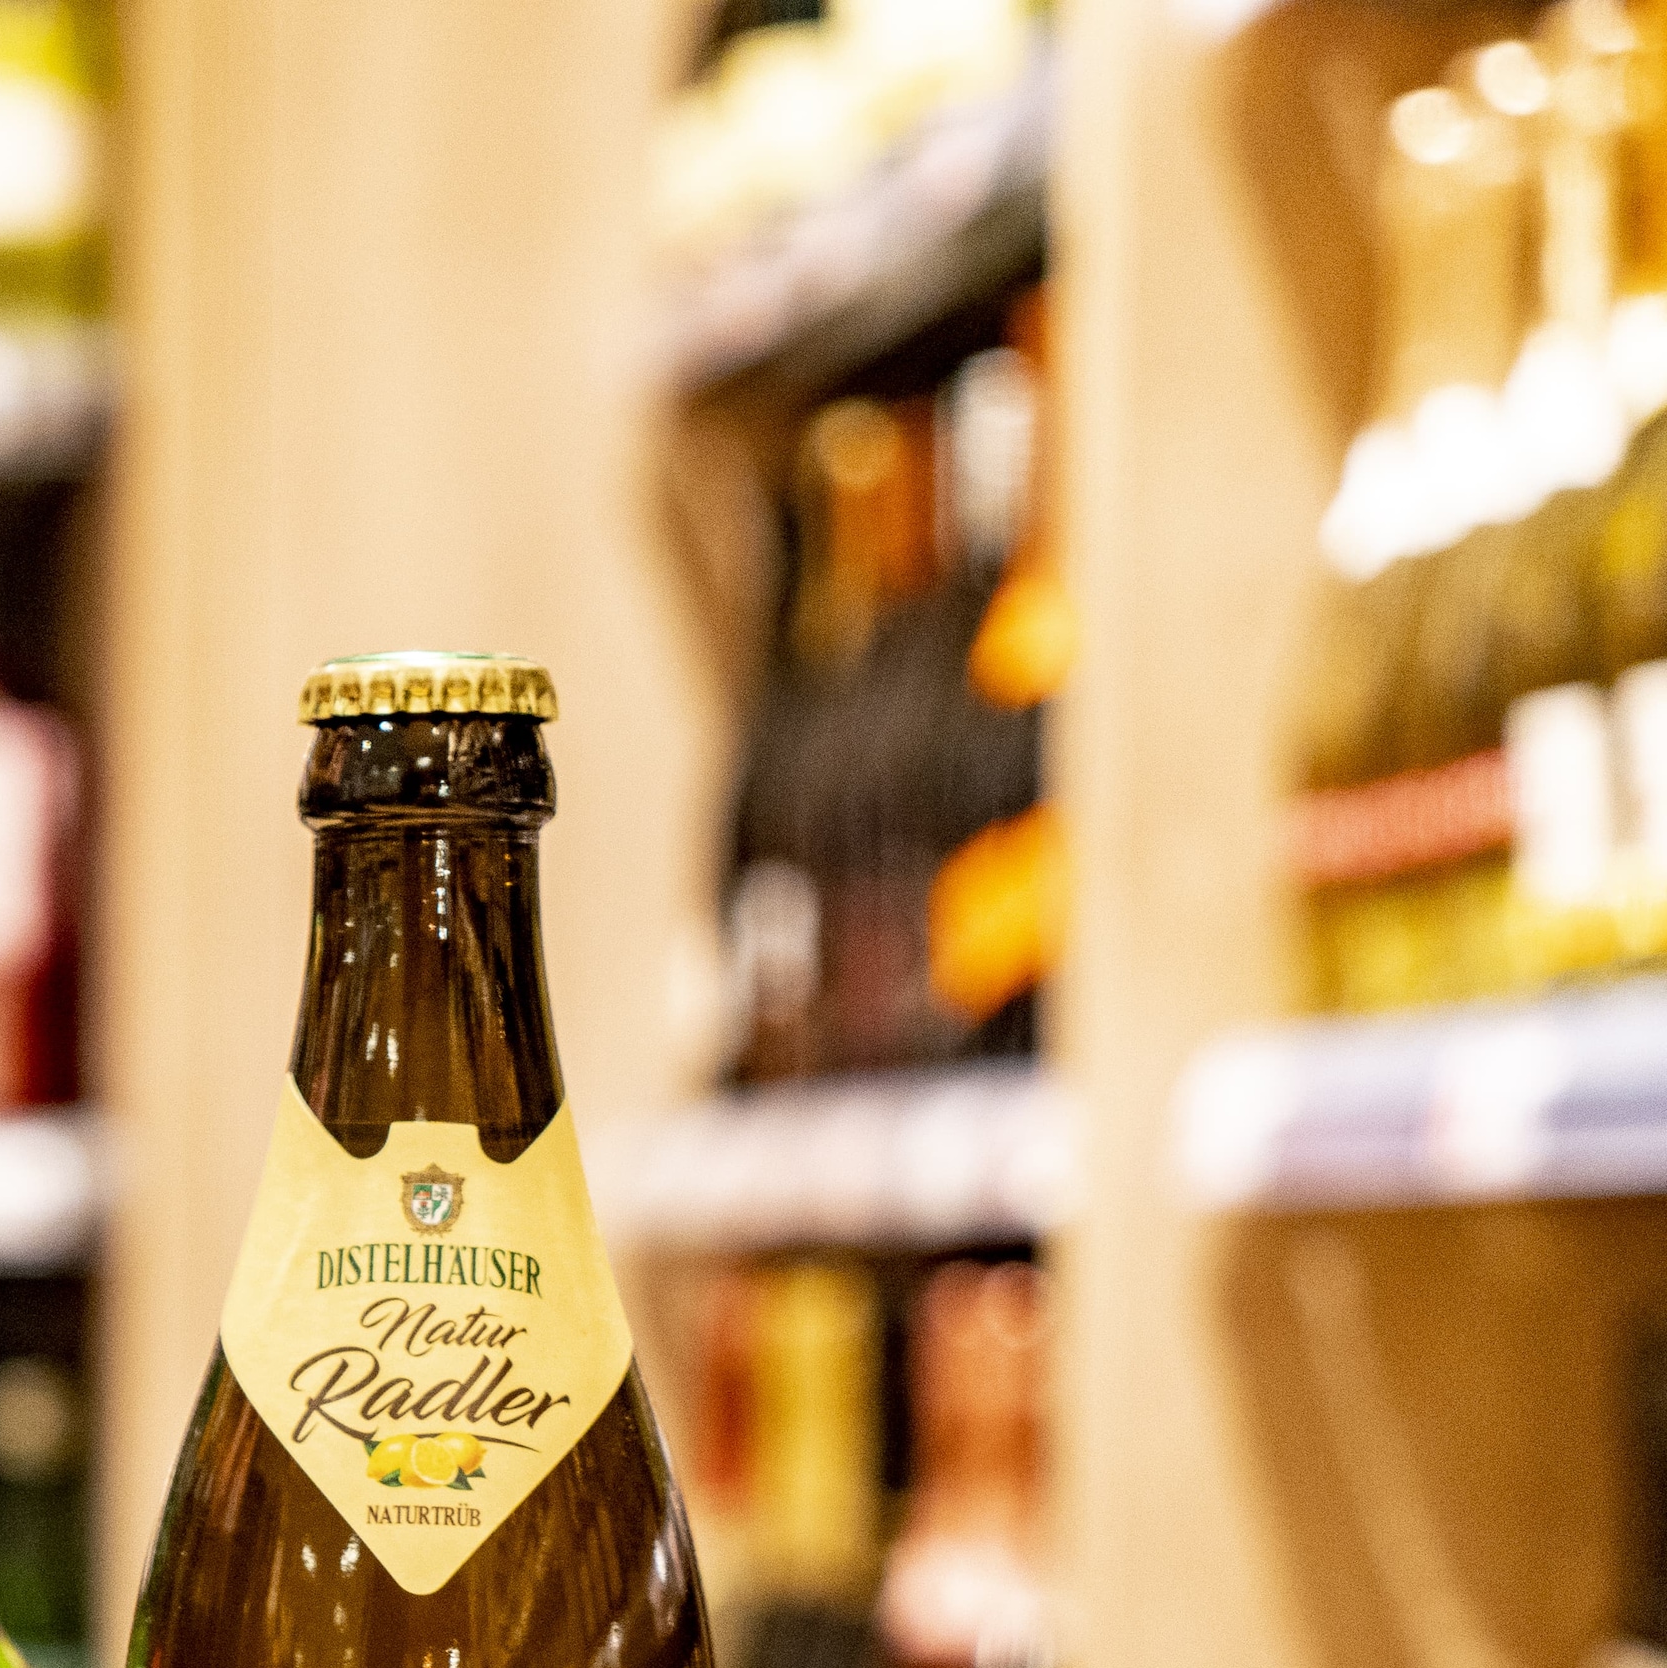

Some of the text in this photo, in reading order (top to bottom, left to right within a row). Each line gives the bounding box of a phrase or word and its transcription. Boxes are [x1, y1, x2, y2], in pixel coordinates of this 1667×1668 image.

[316, 1243, 543, 1299] DISTELHÄUSER
[360, 1296, 527, 1357] Natur
[289, 1346, 570, 1446] Radler
[367, 1502, 481, 1527] NATURTRÜB
